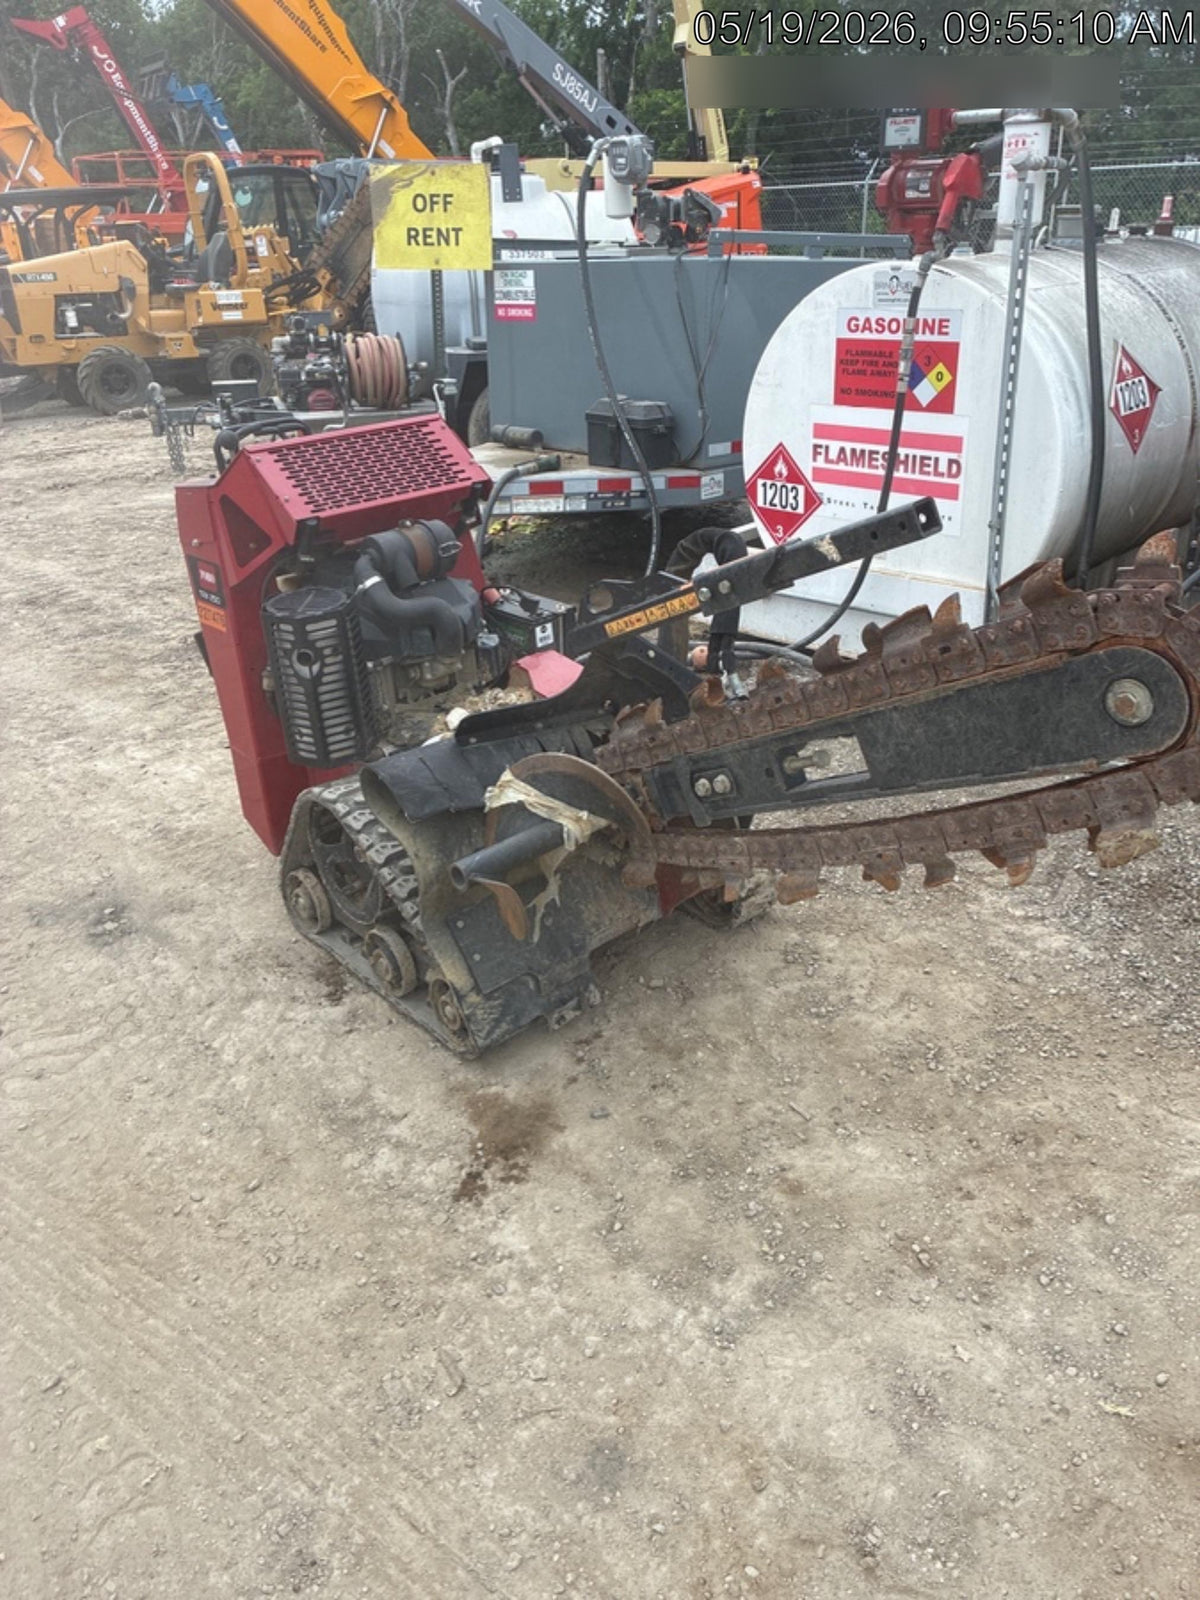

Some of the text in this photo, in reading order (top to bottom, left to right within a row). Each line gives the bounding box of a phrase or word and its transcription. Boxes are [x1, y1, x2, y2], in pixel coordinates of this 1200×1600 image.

[552, 63, 598, 113] SJ85AJ
[412, 193, 454, 213] OFF
[406, 227, 463, 246] RENT
[845, 349, 894, 359] FLAMMABLE
[840, 358, 899, 369] KEEP FIRE AND
[924, 356, 932, 367] 3
[842, 368, 867, 377] FLAME
[935, 371, 944, 383] 0
[840, 387, 853, 396] NO
[1119, 378, 1148, 414] 1203
[1133, 429, 1140, 443] 3
[812, 444, 963, 480] FLAMESHIELD
[761, 482, 800, 511] 1203
[775, 525, 784, 538] 3
